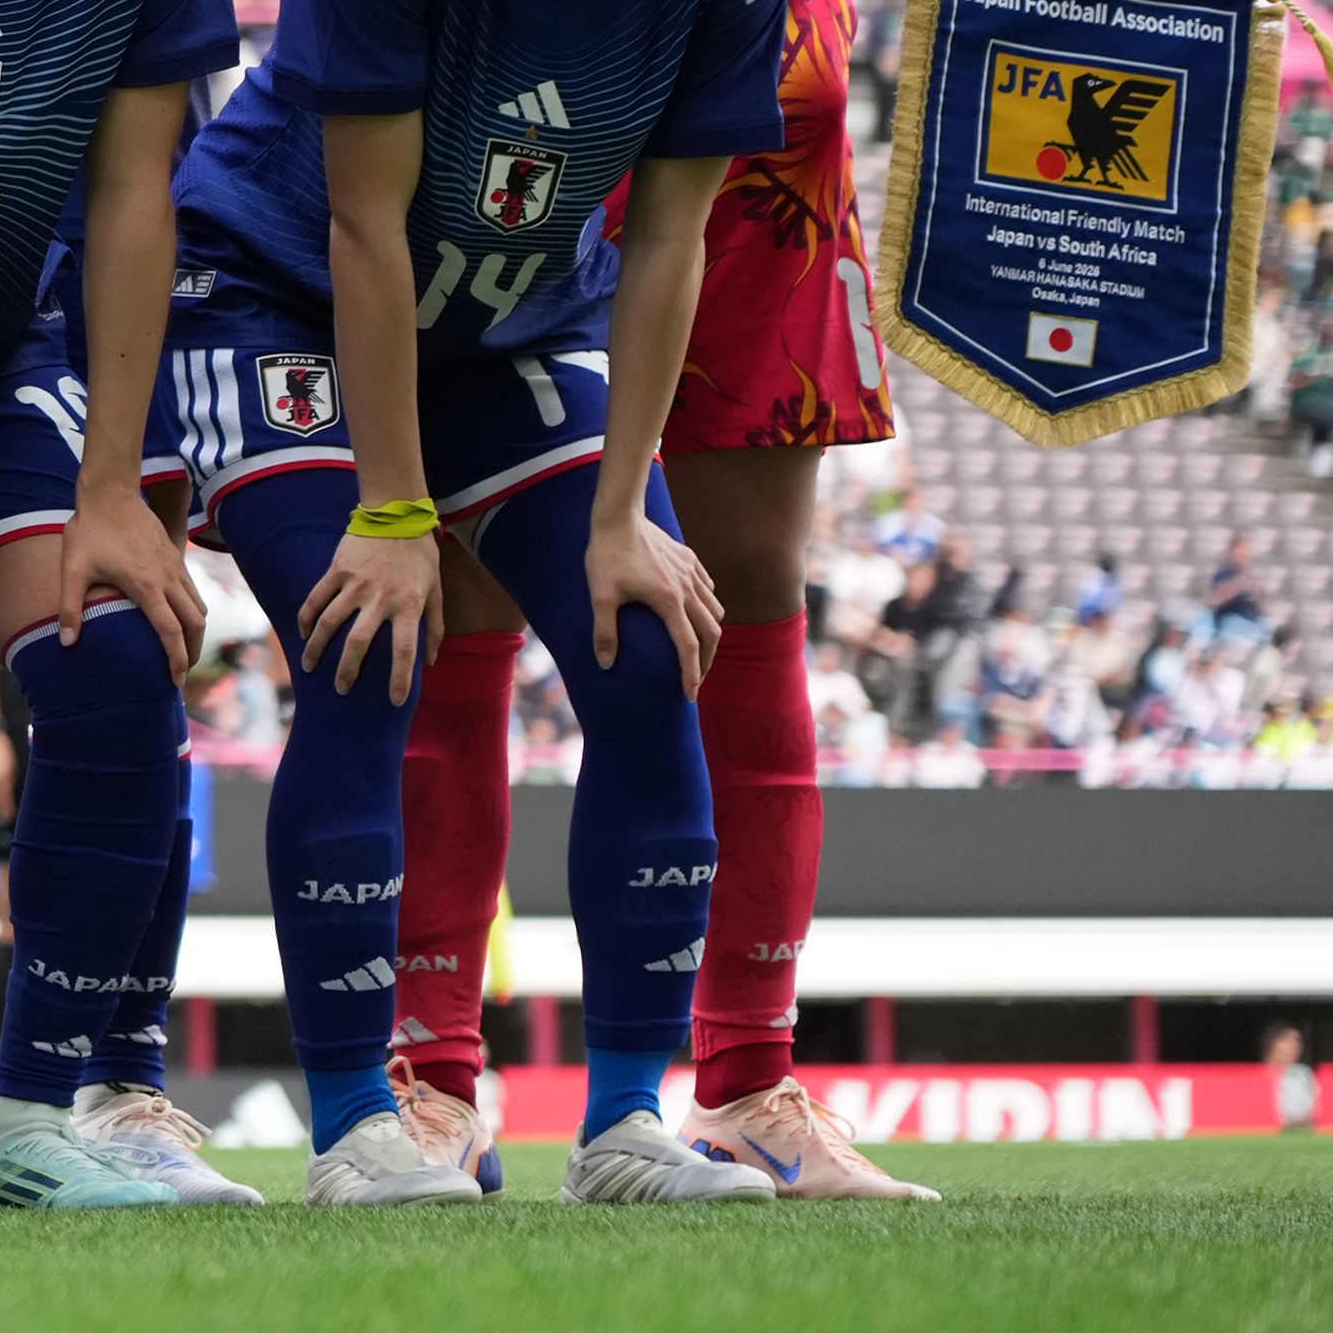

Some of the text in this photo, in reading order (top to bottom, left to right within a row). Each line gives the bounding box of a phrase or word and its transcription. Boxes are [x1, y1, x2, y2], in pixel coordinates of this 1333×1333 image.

[1111, 7, 1225, 43] Association
[997, 64, 1067, 103] JFA
[507, 146, 548, 159] JAPAN
[965, 193, 1186, 243] International Friendly Match
[987, 225, 1157, 265] Japan vs South Africa
[991, 265, 1146, 299] YANMAR HANASAKA STADIUM
[1047, 259, 1073, 273] June
[416, 240, 547, 329] 14
[1068, 291, 1100, 307] Japan
[837, 257, 881, 389] 1
[276, 357, 316, 365] JAPAN
[286, 409, 320, 422] JFA
[629, 862, 717, 887] JAP
